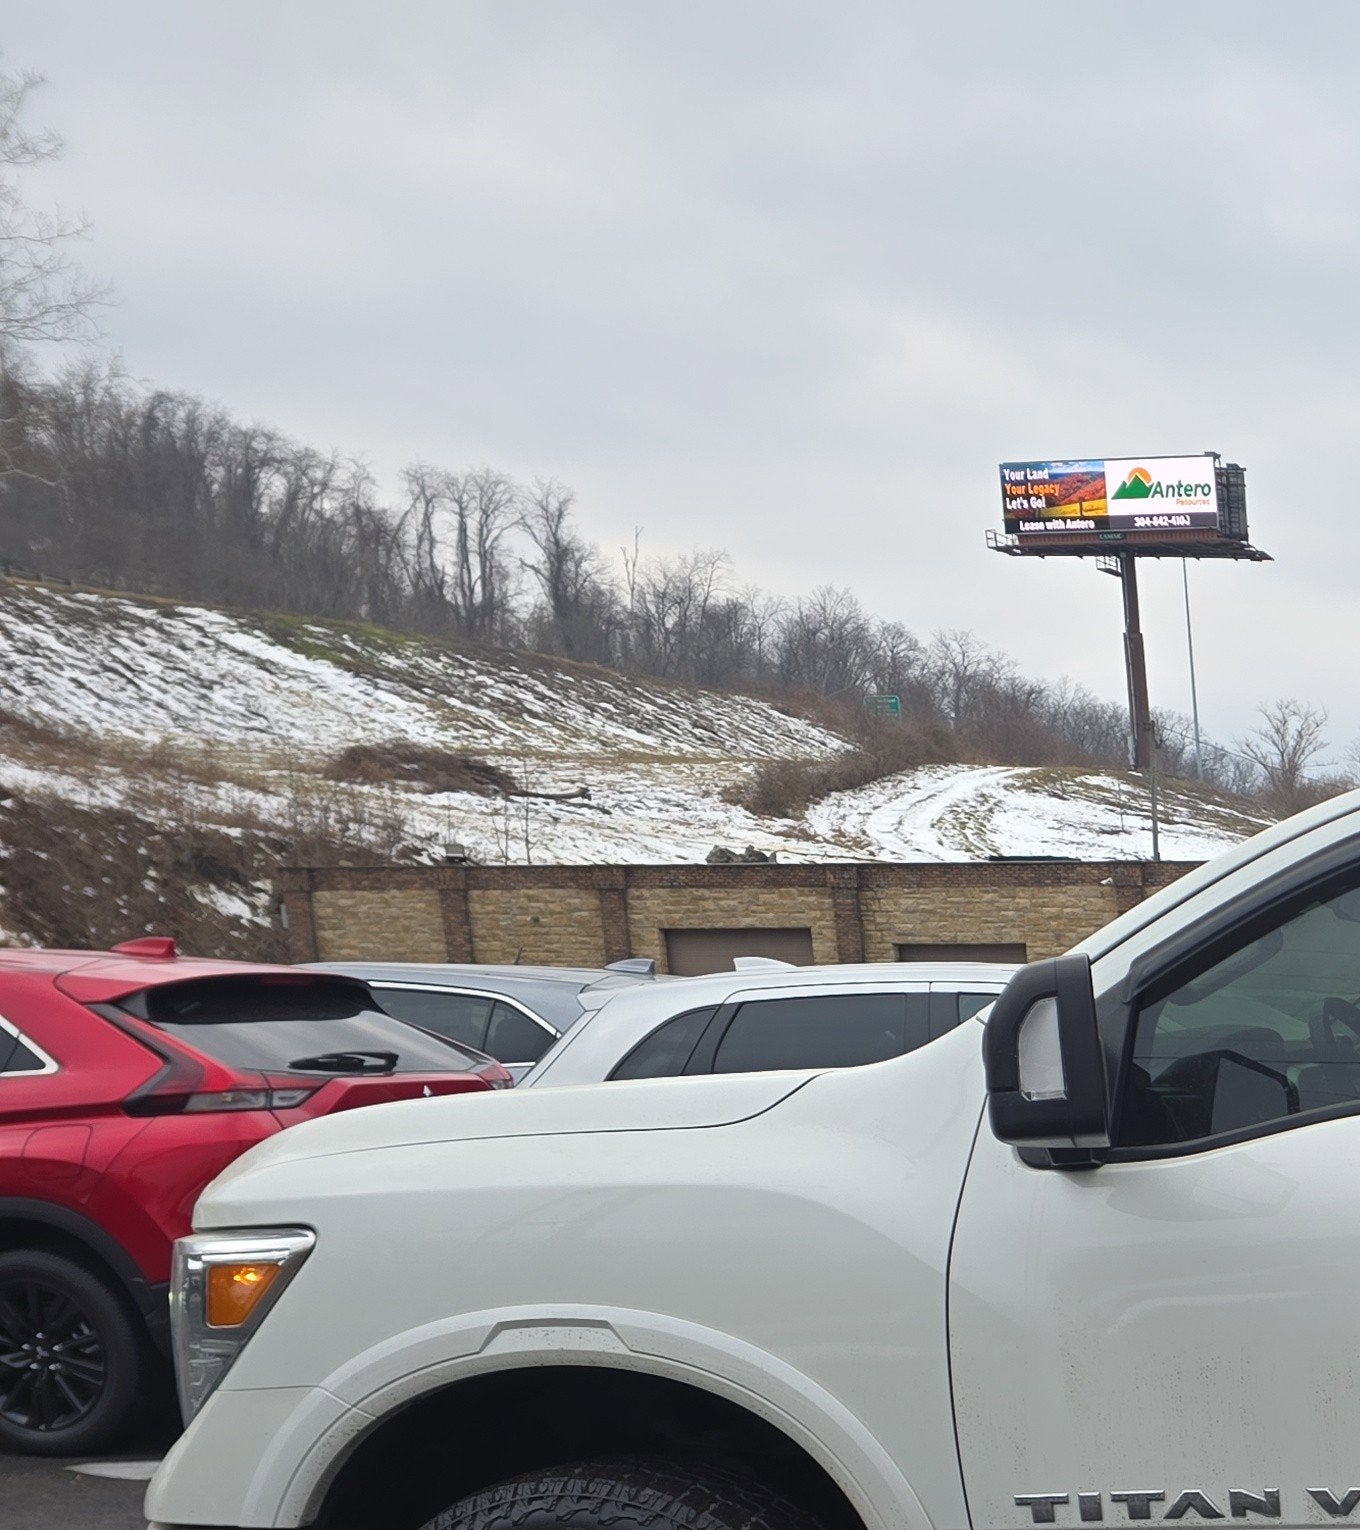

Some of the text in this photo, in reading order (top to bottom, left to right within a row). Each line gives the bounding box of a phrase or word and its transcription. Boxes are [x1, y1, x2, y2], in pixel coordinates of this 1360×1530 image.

[1003, 468, 1049, 480] Your Land
[1005, 482, 1060, 496] Your Legacy
[1151, 480, 1212, 498] Antero
[1006, 496, 1029, 510] Let's
[1019, 519, 1096, 531] Lease with Antero
[1014, 1487, 1281, 1523] TITAN
